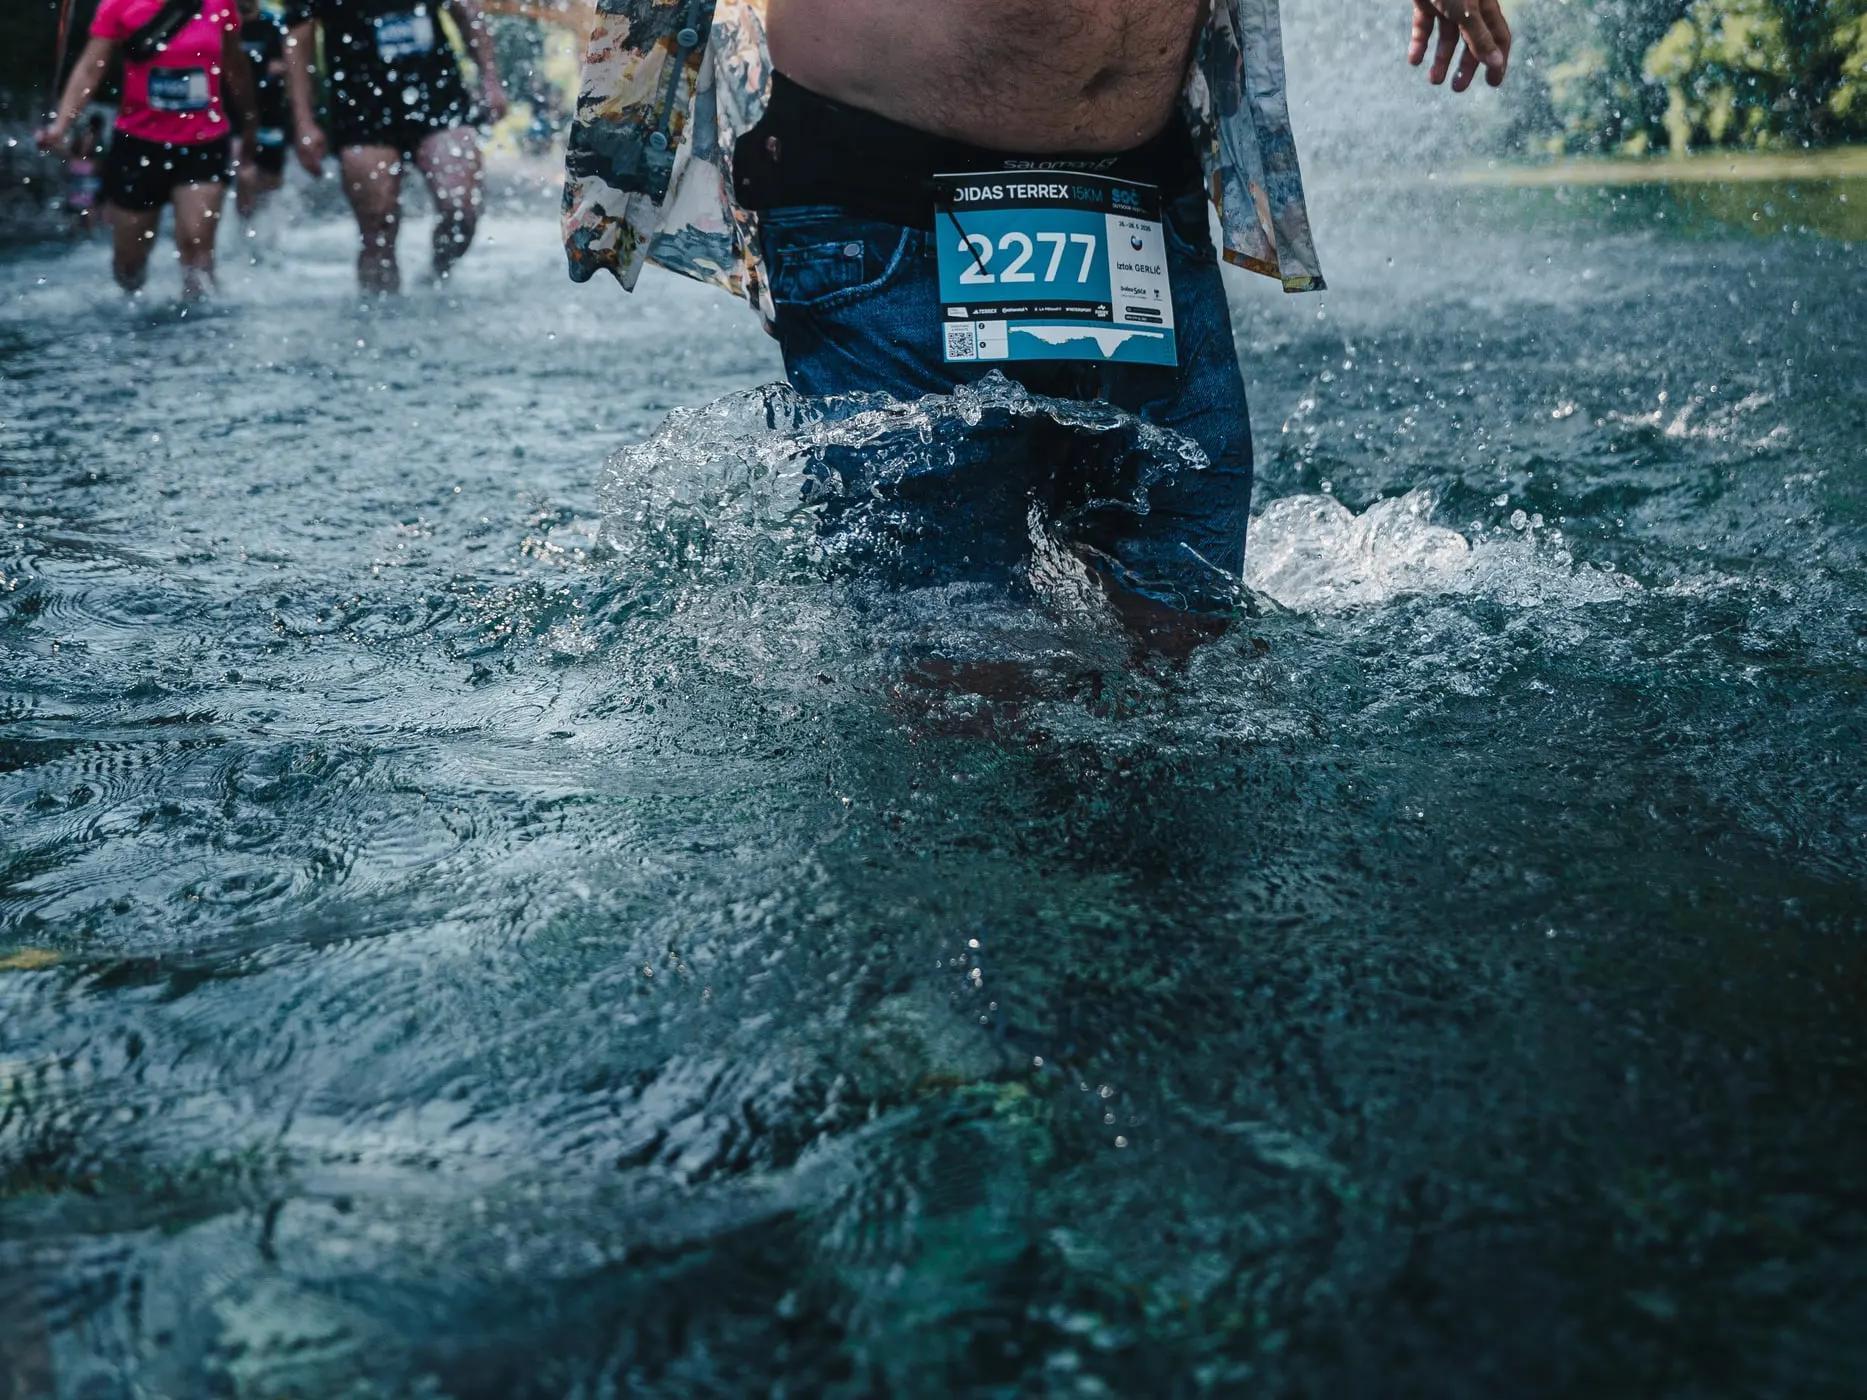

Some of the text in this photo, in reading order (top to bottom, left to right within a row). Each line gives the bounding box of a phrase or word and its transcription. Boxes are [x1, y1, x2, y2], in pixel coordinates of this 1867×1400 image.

[953, 184, 1103, 202] DIDAS TERREX 15KM
[958, 231, 1097, 285] 2277
[1117, 260, 1133, 271] Iztok
